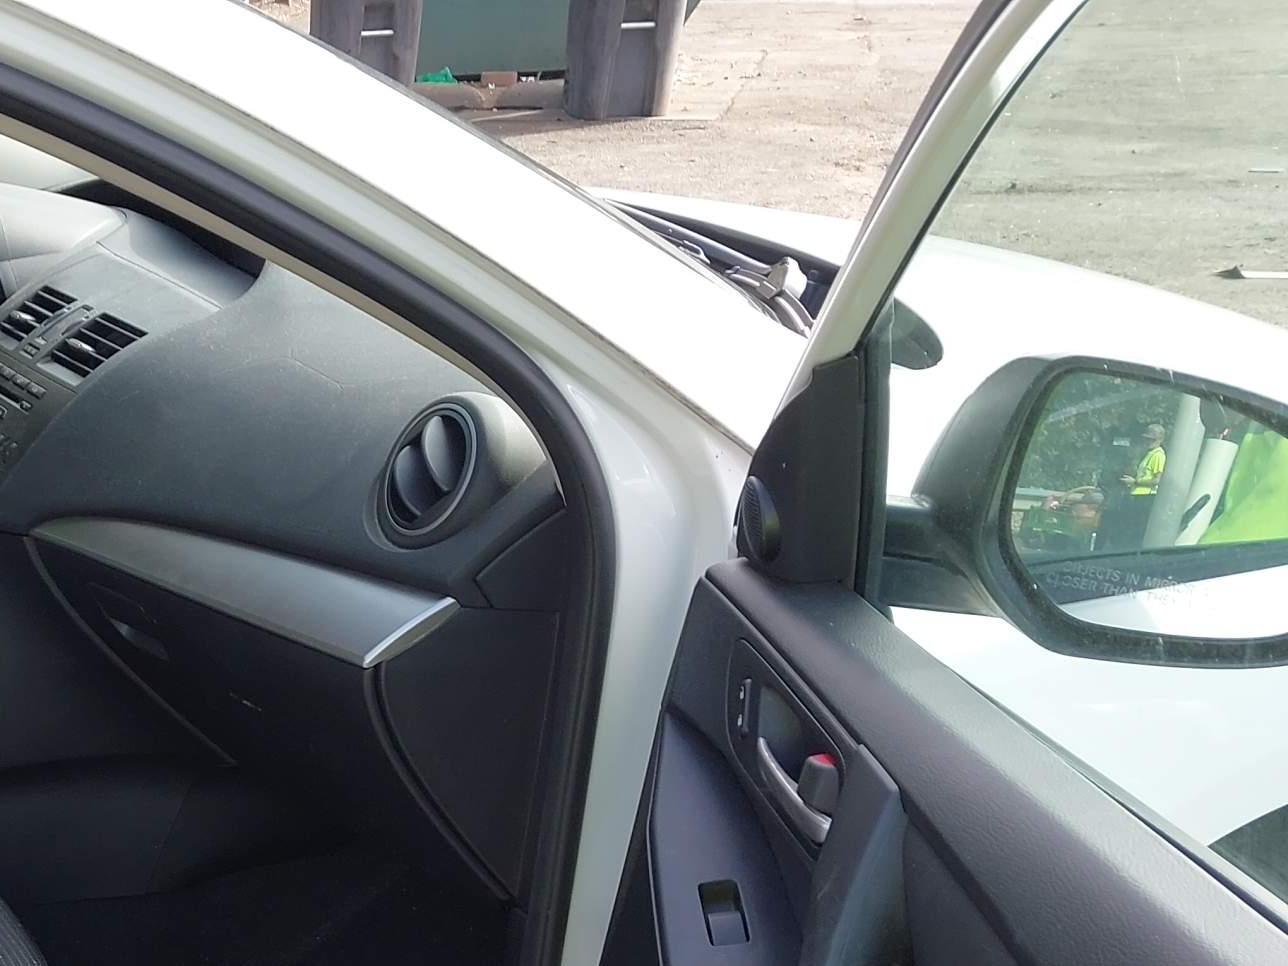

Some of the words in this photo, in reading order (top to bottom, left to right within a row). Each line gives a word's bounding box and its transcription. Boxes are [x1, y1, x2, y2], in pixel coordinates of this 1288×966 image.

[1046, 571, 1097, 591] CLOSER
[1102, 582, 1138, 599] THAN
[1063, 561, 1121, 582] OBJECTS
[1125, 572, 1141, 585] IN
